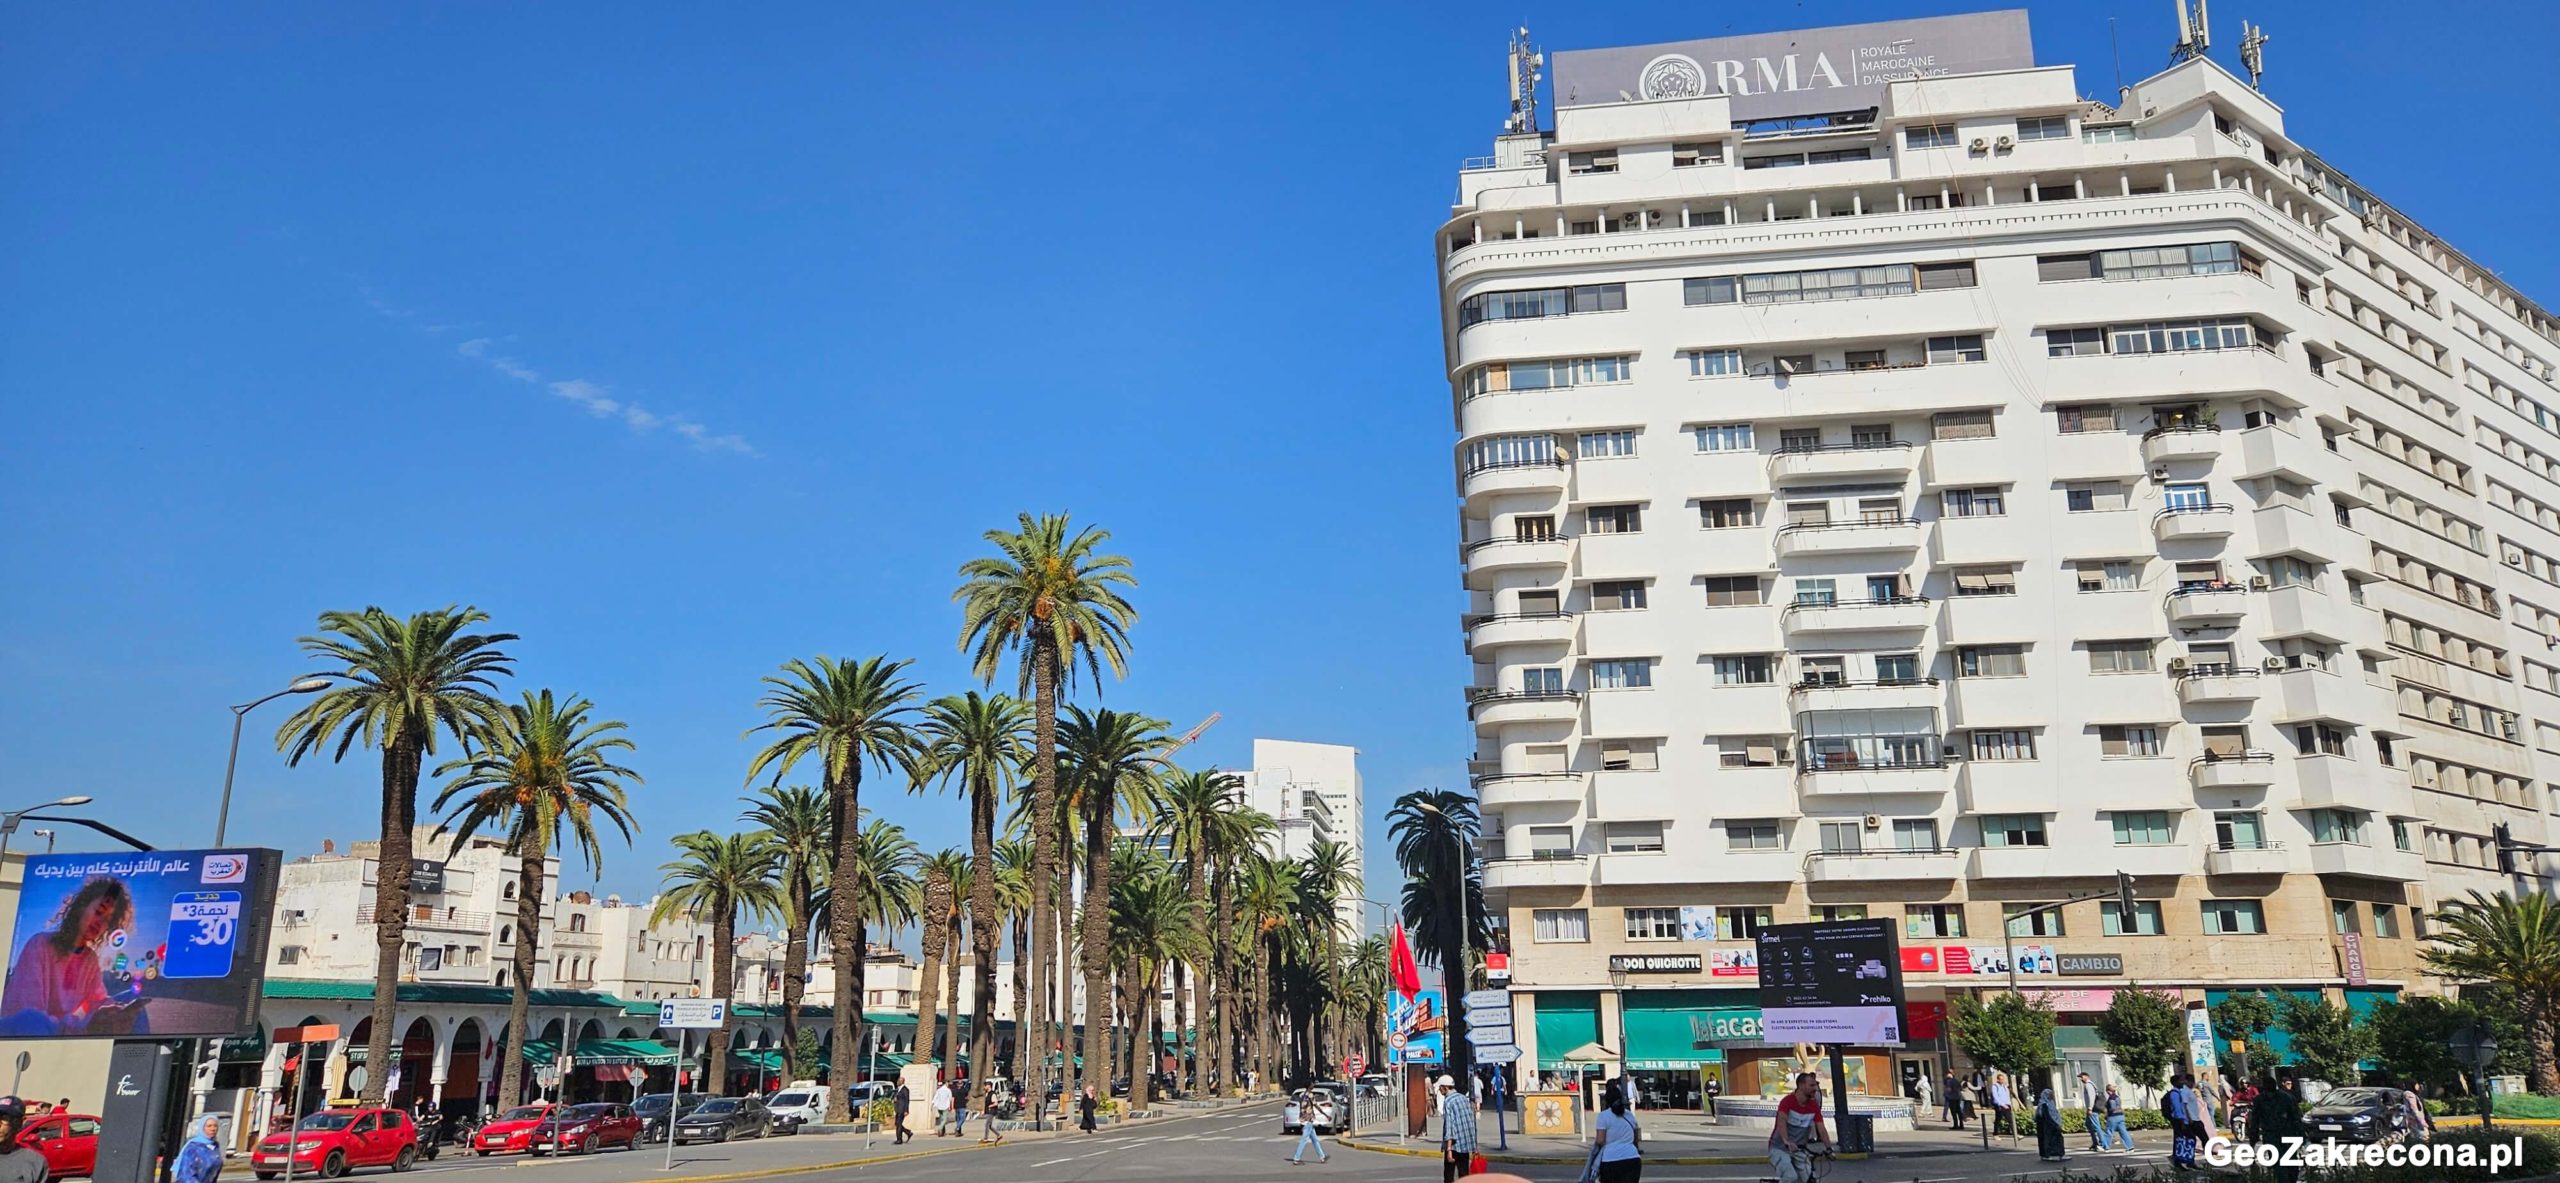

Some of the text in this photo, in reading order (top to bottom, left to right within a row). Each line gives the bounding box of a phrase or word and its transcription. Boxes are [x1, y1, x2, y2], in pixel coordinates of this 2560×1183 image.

[1860, 44, 1907, 58] ROYALE
[1862, 55, 1936, 71] MAROCAINE
[1712, 52, 1848, 96] RMA
[1863, 68, 1949, 85] D'ASSURNCE
[34, 863, 65, 878] يديك
[65, 863, 84, 877] بين
[161, 860, 190, 876] عالم
[195, 919, 233, 945] 30
[1623, 957, 1645, 969] DON
[1646, 957, 1701, 969] QUICHOTTE
[2345, 935, 2361, 977] CHANGE
[2060, 957, 2121, 970] CAMBIO
[2071, 990, 2089, 998] DE
[713, 1008, 721, 1018] P
[1645, 1061, 1664, 1069] BAR
[1668, 1061, 1688, 1069] NIGHT
